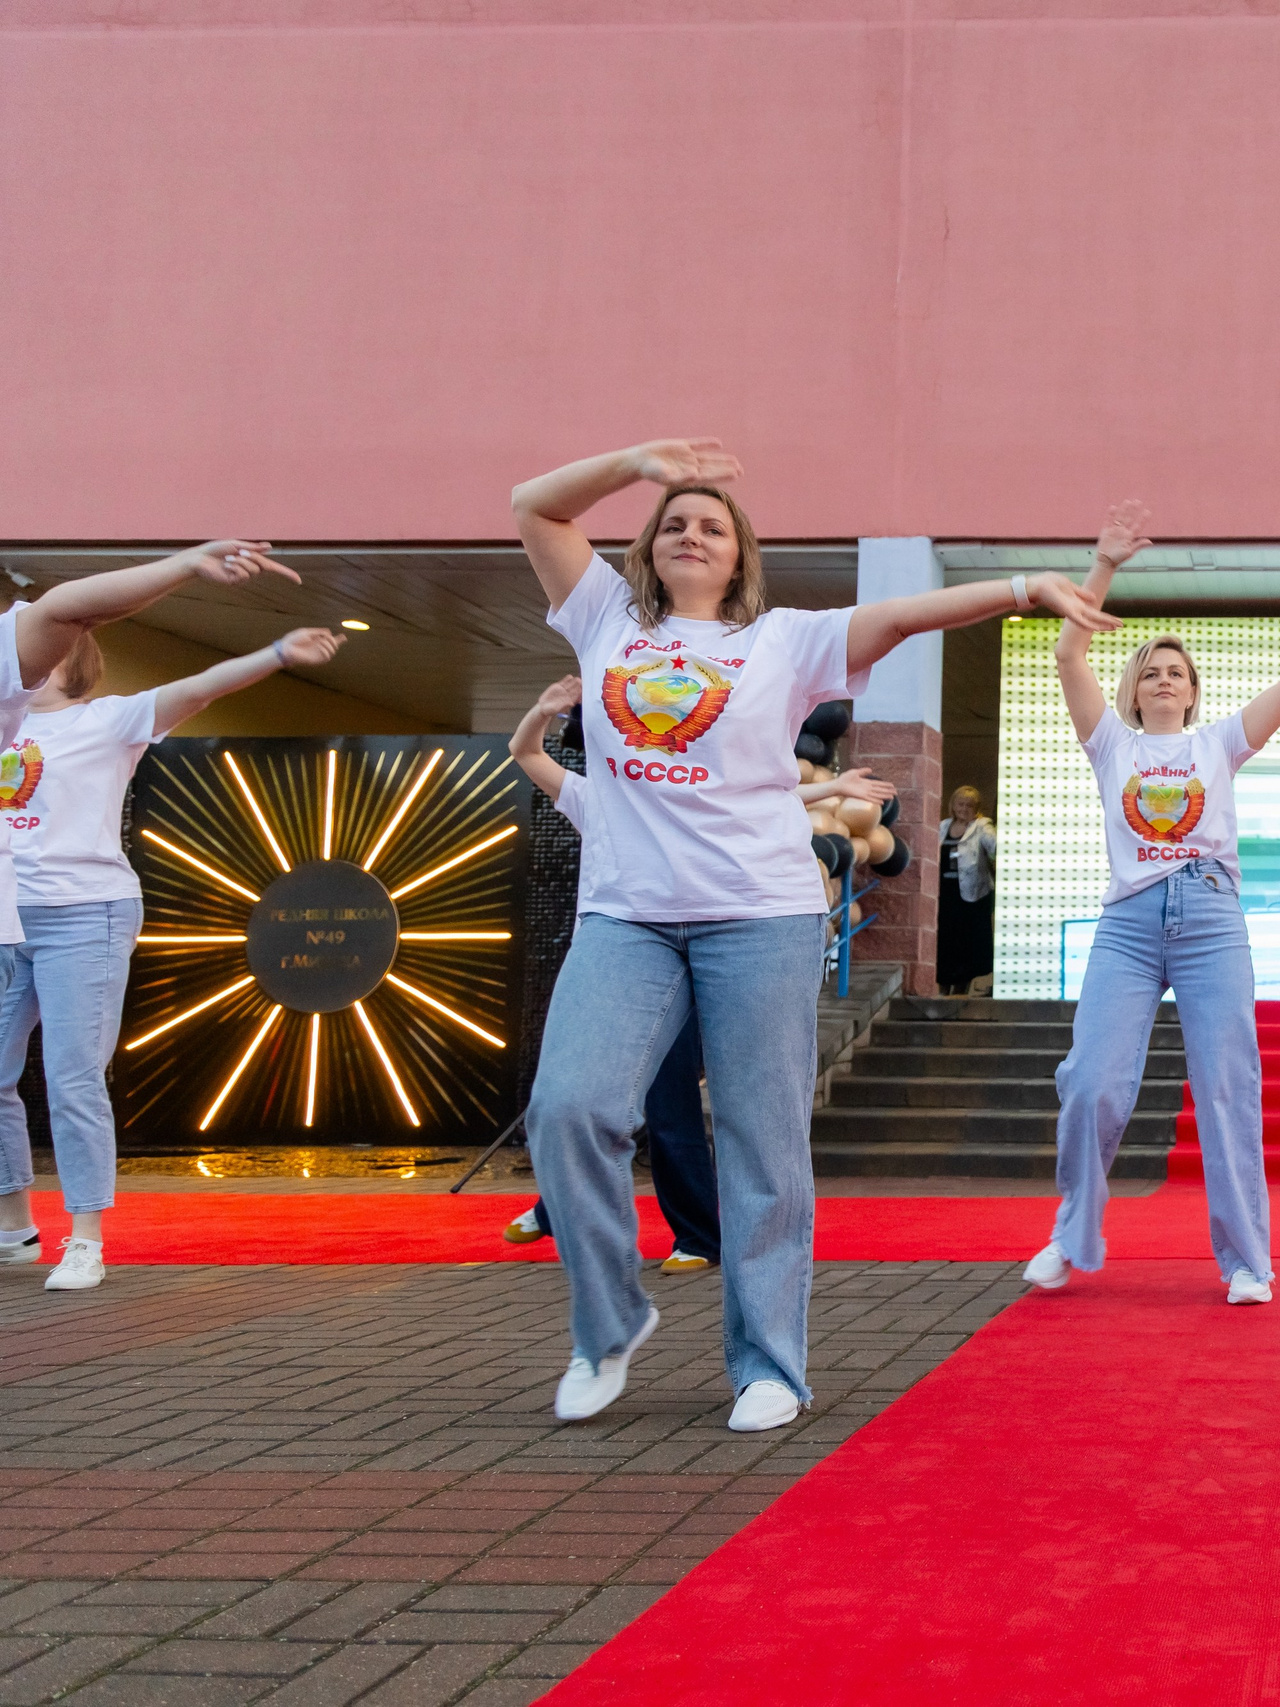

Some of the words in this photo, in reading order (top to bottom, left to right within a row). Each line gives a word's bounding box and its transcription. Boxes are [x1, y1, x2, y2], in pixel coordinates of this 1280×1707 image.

[624, 638, 746, 669] РОЖДАЯ
[623, 758, 709, 785] СССР
[306, 930, 346, 945] №49
